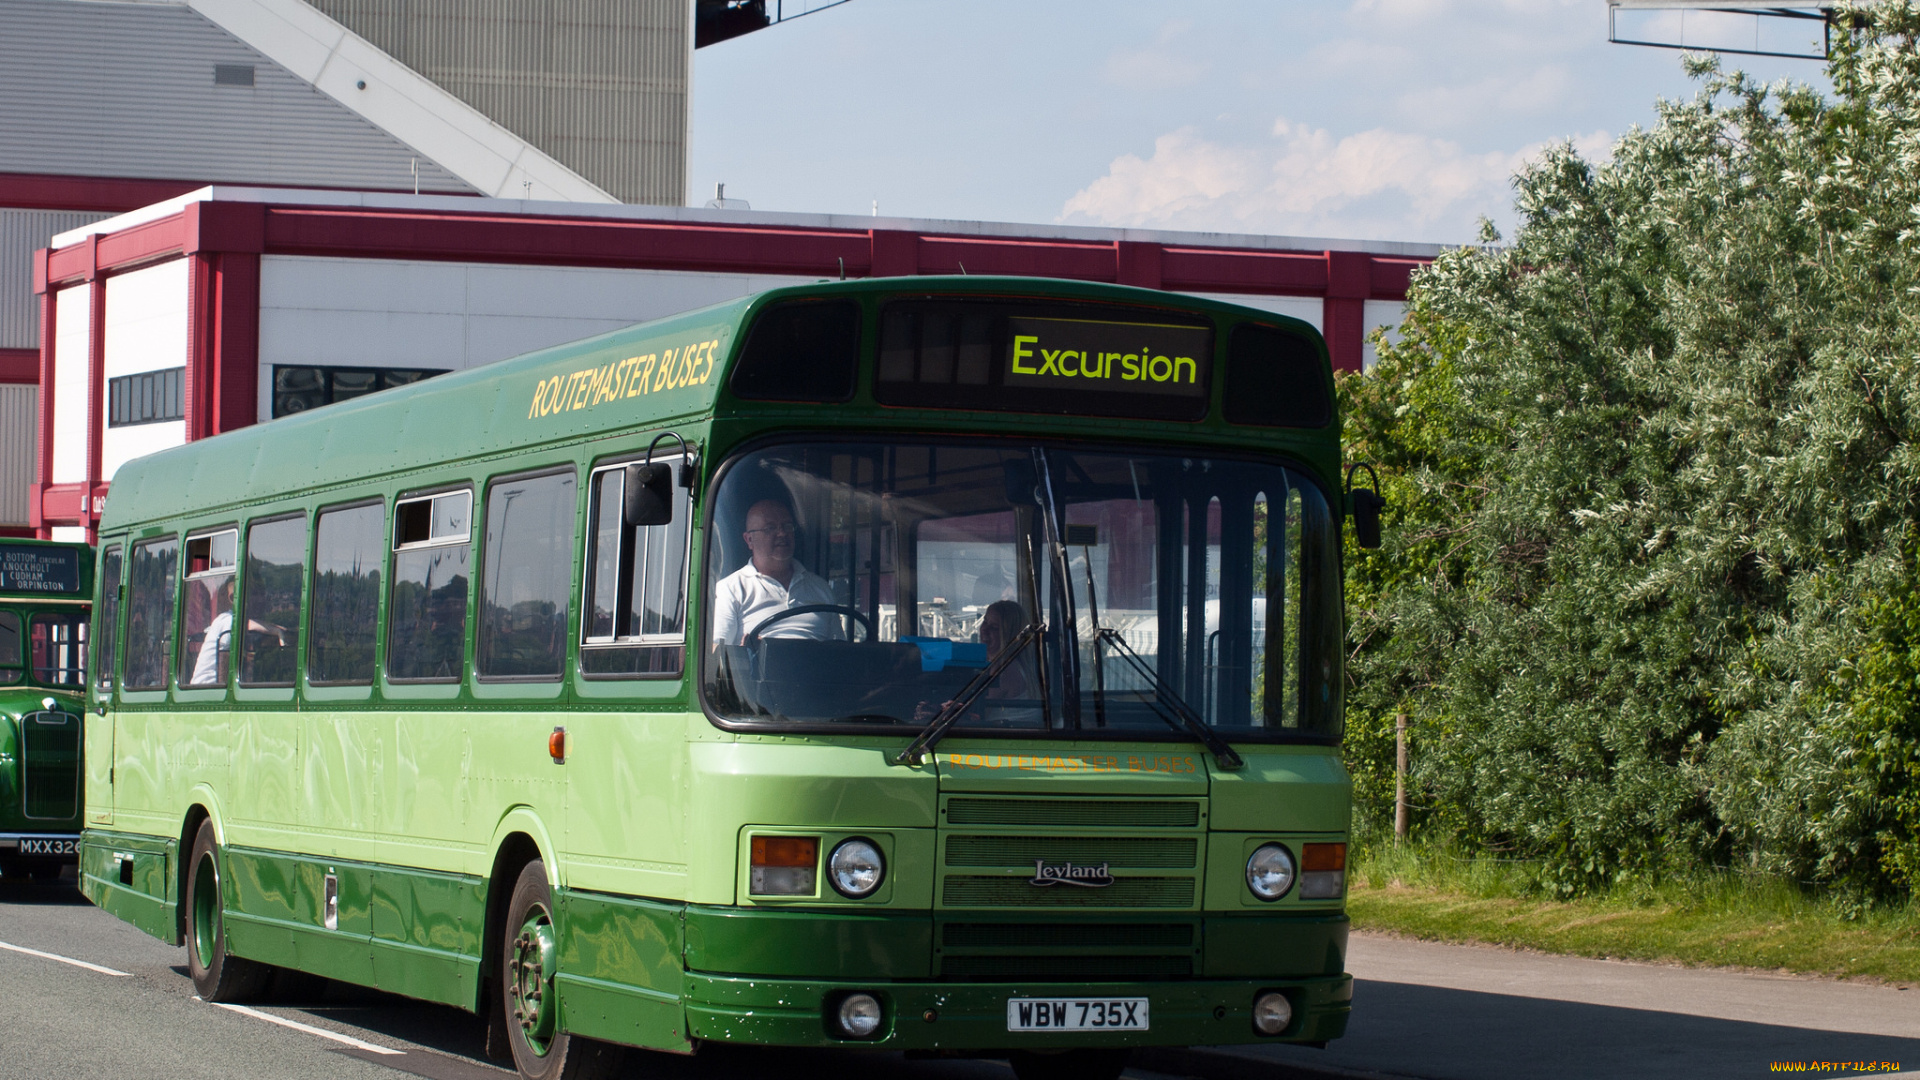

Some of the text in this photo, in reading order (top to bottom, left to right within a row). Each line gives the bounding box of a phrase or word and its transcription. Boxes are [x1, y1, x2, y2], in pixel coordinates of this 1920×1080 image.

[1012, 335, 1196, 383] Excursion
[528, 339, 719, 419] ROUTEMASTER BUSES
[3, 562, 50, 573] KNOCKHOLT
[6, 552, 36, 562] BOTTOM
[9, 571, 43, 581] CUDHAM
[17, 581, 64, 591] ORPINGTON
[950, 753, 1195, 774] ROUTEMASTER BUSES
[1029, 859, 1114, 887] Leyland
[1018, 1002, 1138, 1027] WBW 735X
